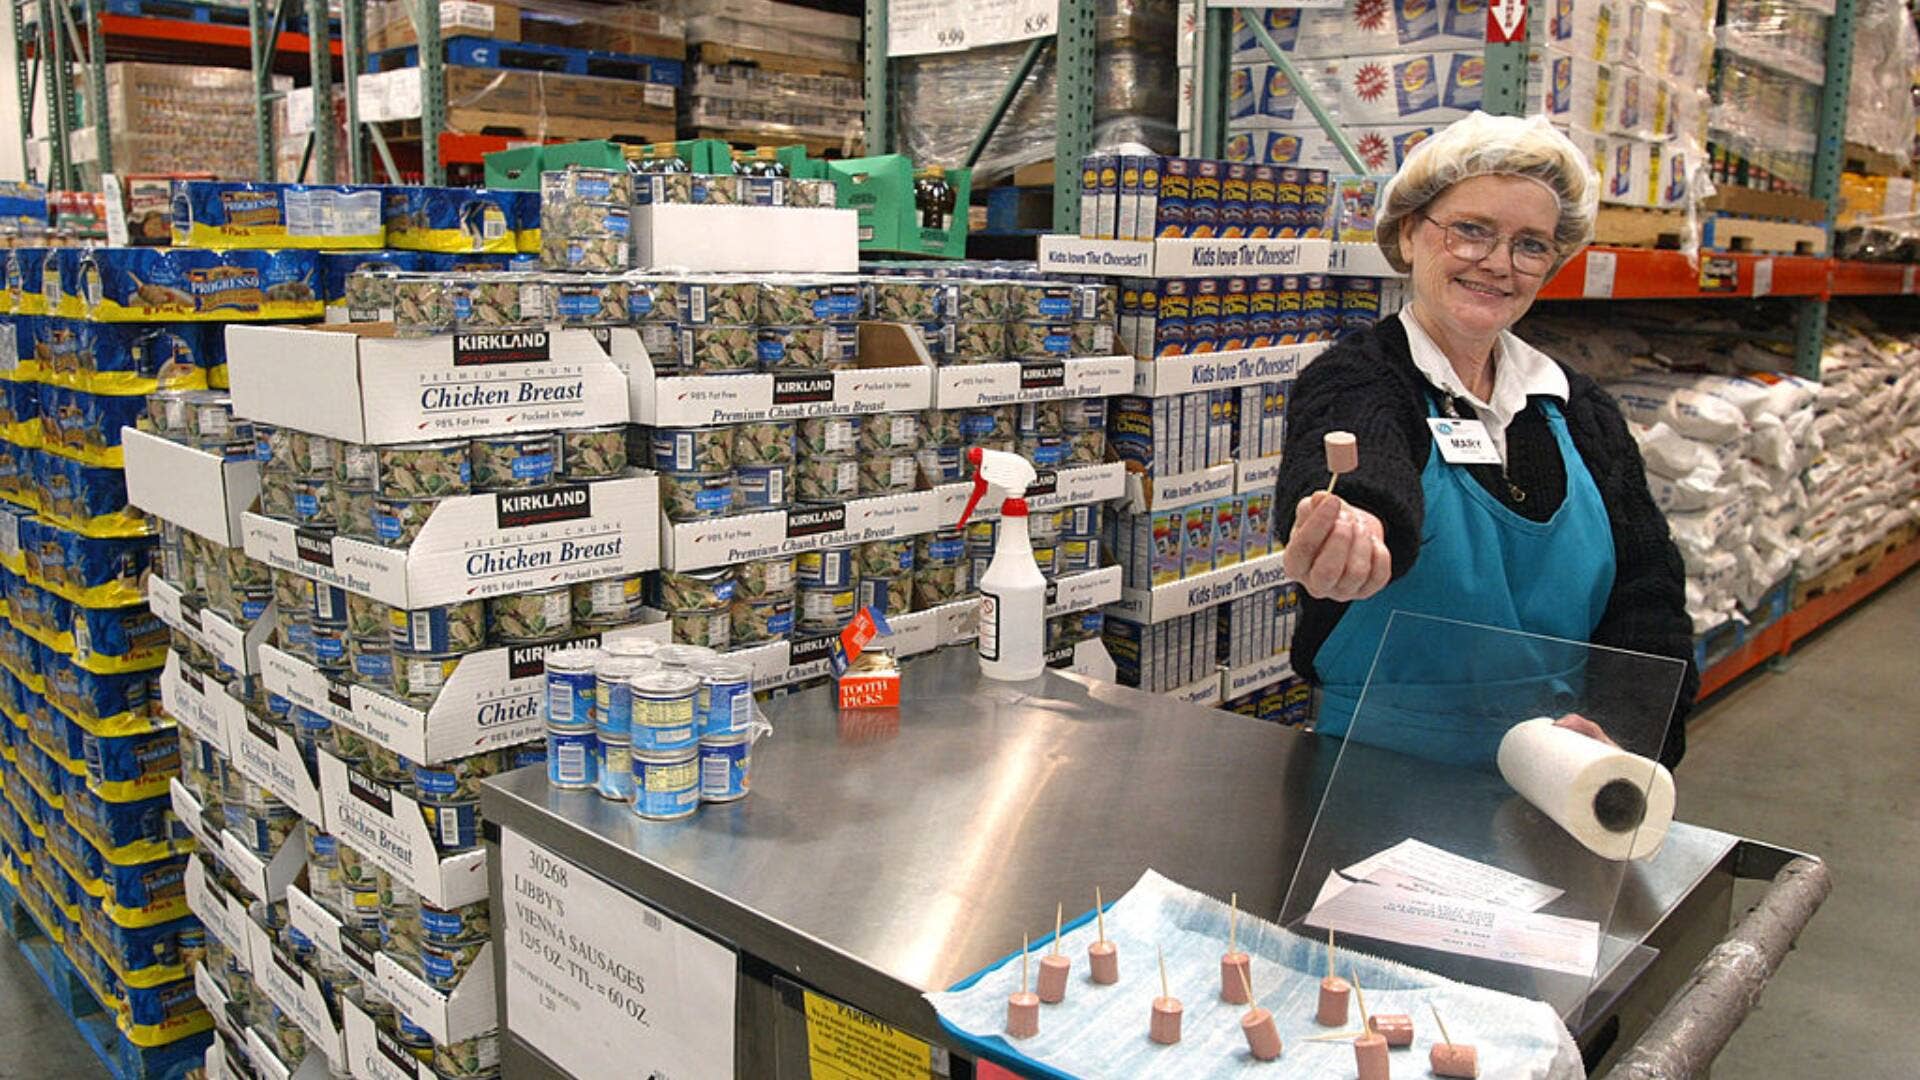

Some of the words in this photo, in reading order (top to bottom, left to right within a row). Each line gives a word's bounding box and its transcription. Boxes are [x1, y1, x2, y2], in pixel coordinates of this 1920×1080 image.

[223, 199, 279, 212] PROGRESSO
[1049, 251, 1067, 263] Kids
[1191, 247, 1215, 267] Kids
[1217, 246, 1238, 265] love
[1239, 245, 1256, 265] The
[1256, 245, 1296, 265] Cheesiest
[190, 277, 261, 294] PROGRESSO
[458, 333, 547, 351] KIRKLAND
[420, 371, 507, 382] PREMIUM
[524, 366, 583, 377] CHUNK
[1192, 365, 1215, 384] Kids
[1216, 363, 1237, 381] love
[1238, 357, 1255, 379] The
[421, 386, 509, 410] Chicken
[518, 381, 583, 402] Breast
[776, 379, 832, 393] KIRKLAND
[472, 416, 490, 425] Free
[712, 409, 765, 422] Premium
[768, 405, 805, 420] Chunk
[808, 401, 850, 416] Chicken
[853, 400, 886, 412] Breast
[1450, 438, 1482, 449] MARY
[501, 490, 587, 513] KIRKLAND
[789, 509, 844, 527] KIRKLAND
[464, 532, 549, 549] PREMIUM
[727, 544, 779, 561] Premium
[781, 537, 818, 552] Chunk
[820, 531, 861, 547] Chicken
[864, 526, 896, 541] Breast
[466, 548, 551, 576] Chicken
[560, 537, 623, 562] Breast
[1188, 581, 1210, 608] Kids
[1212, 578, 1232, 599] love
[1233, 573, 1250, 594] The
[514, 638, 598, 664] KIRKLAND
[842, 681, 888, 697] TOOTH
[477, 696, 539, 727] Chick
[842, 693, 884, 709] PICKS
[338, 804, 376, 842] Chicken
[379, 829, 414, 866] Breast
[529, 850, 568, 888] 30268
[514, 873, 566, 917] LIBBY'S
[515, 901, 567, 947] VIENNA
[569, 933, 646, 995] SAUSAGES
[519, 928, 542, 955] 12/5
[567, 959, 595, 991] TTL
[608, 986, 624, 1010] 60
[626, 998, 651, 1028] OZ.
